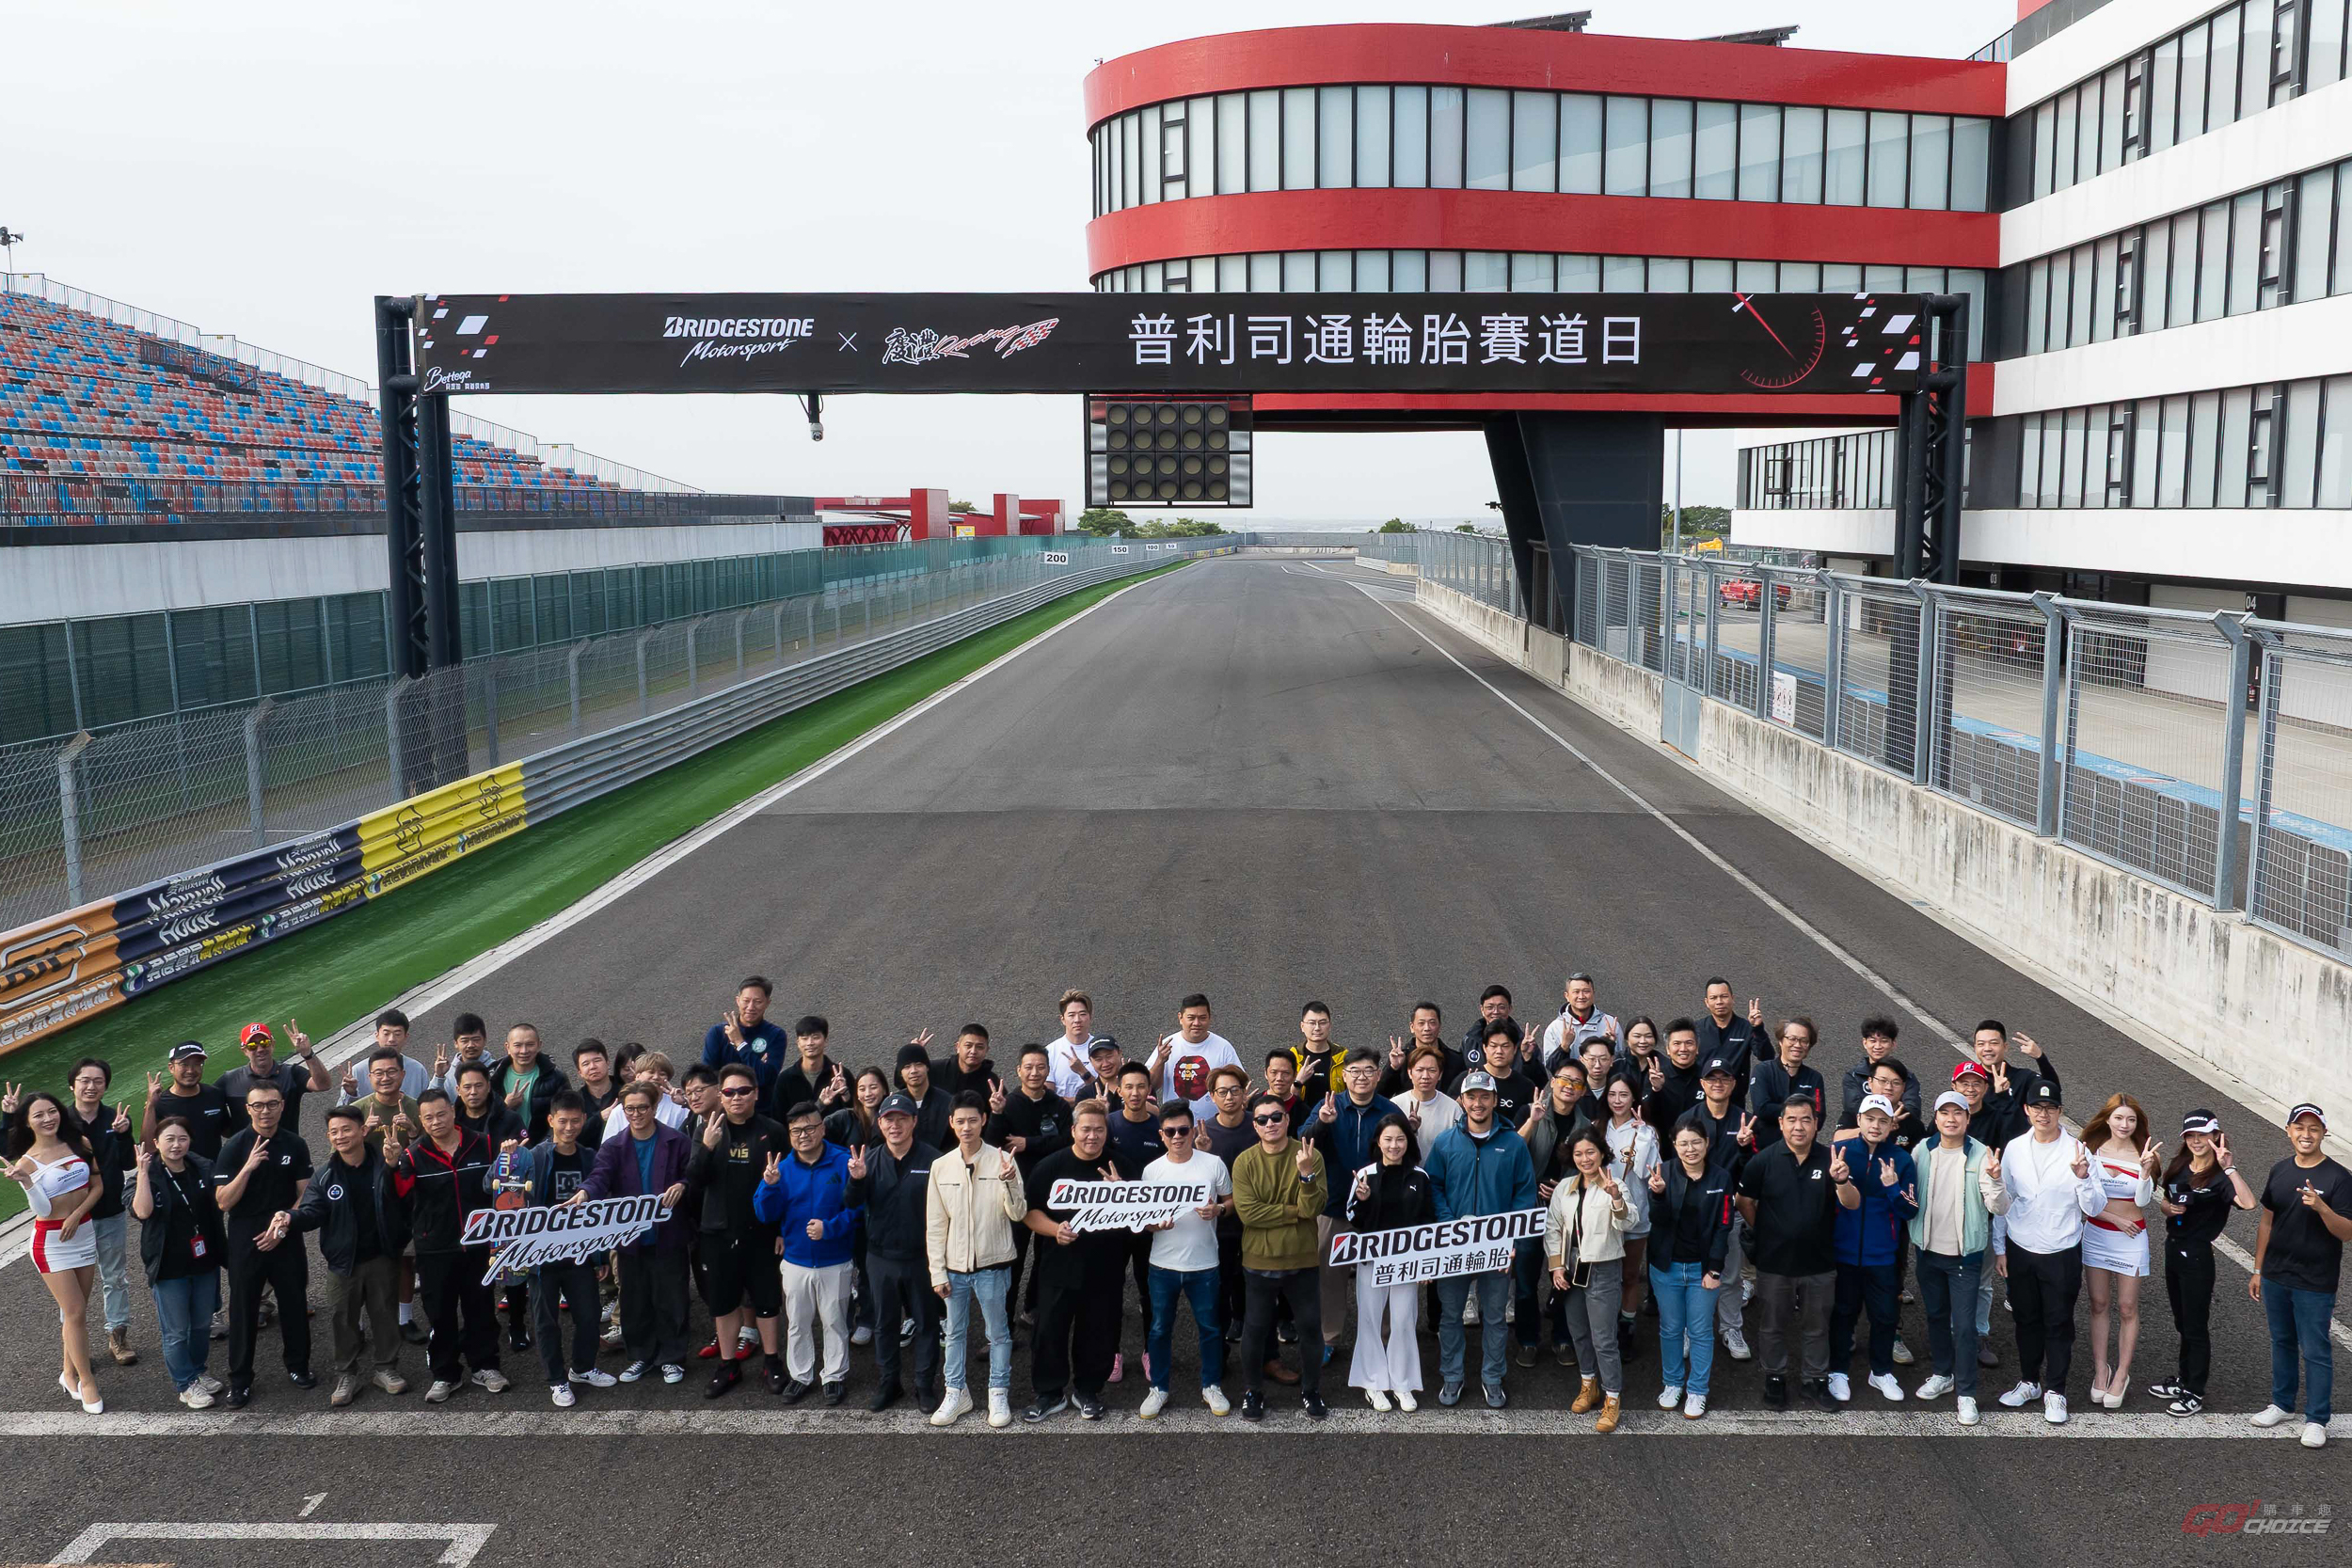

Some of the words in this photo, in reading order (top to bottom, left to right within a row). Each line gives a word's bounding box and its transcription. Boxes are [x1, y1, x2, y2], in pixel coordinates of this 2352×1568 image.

[663, 317, 815, 338] BRIDGESTONE
[1129, 312, 1641, 365] 普利司通輪胎賽道日
[679, 339, 798, 368] Motorsport
[1046, 554, 1067, 563] 200
[1990, 573, 1997, 584] 03
[2246, 595, 2257, 610] 04
[286, 867, 336, 900] House
[158, 908, 220, 945] House
[1053, 1184, 1206, 1204] BRIDGESTONE
[464, 1197, 672, 1243] BRIDGESTONE
[1071, 1205, 1188, 1232] Motorsport
[1331, 1210, 1546, 1264] BRIDGESTONE
[485, 1225, 651, 1282] Motorsport
[1375, 1247, 1510, 1286] 普利司通輪胎
